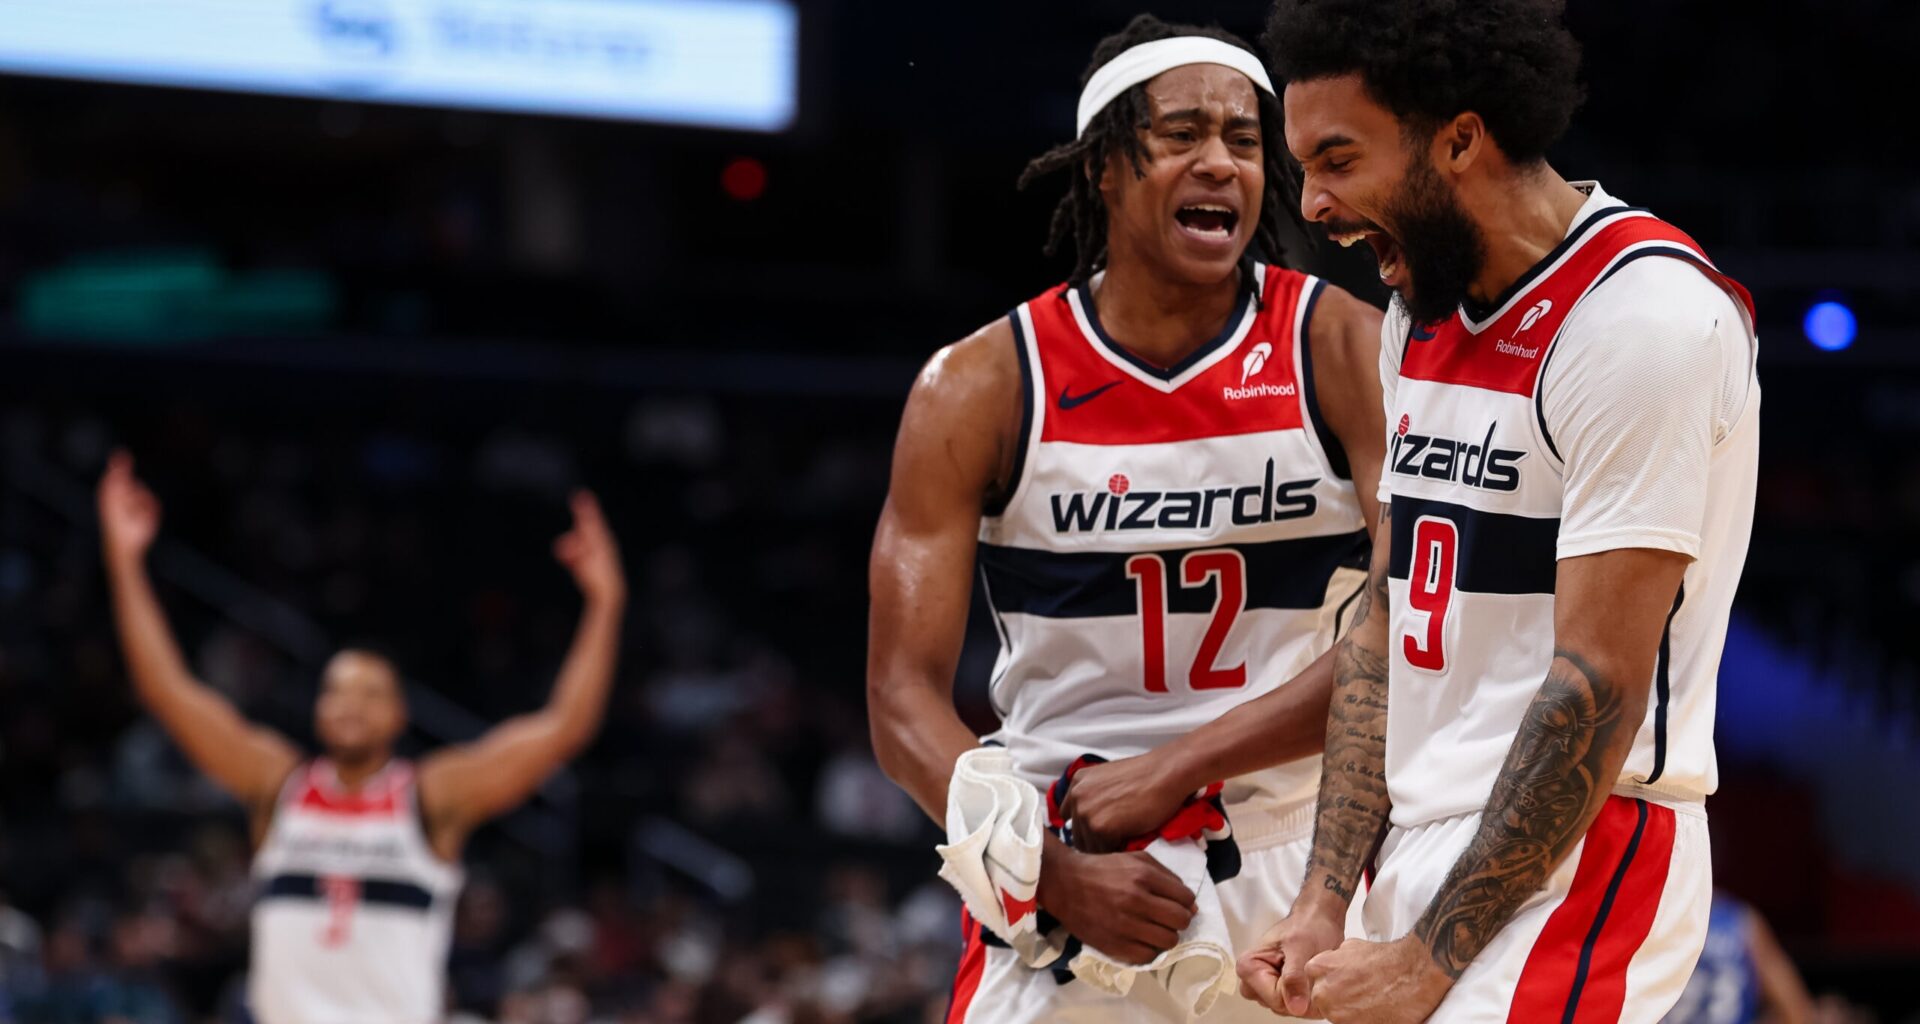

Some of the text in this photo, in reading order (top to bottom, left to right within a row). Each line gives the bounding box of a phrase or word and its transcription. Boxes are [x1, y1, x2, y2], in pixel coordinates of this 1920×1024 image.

[1495, 339, 1539, 359] Robinhood
[1223, 382, 1295, 400] Robinhood
[1391, 413, 1528, 491] izards
[1050, 456, 1321, 533] wizards
[1126, 549, 1247, 693] 12
[1403, 517, 1457, 673] 9
